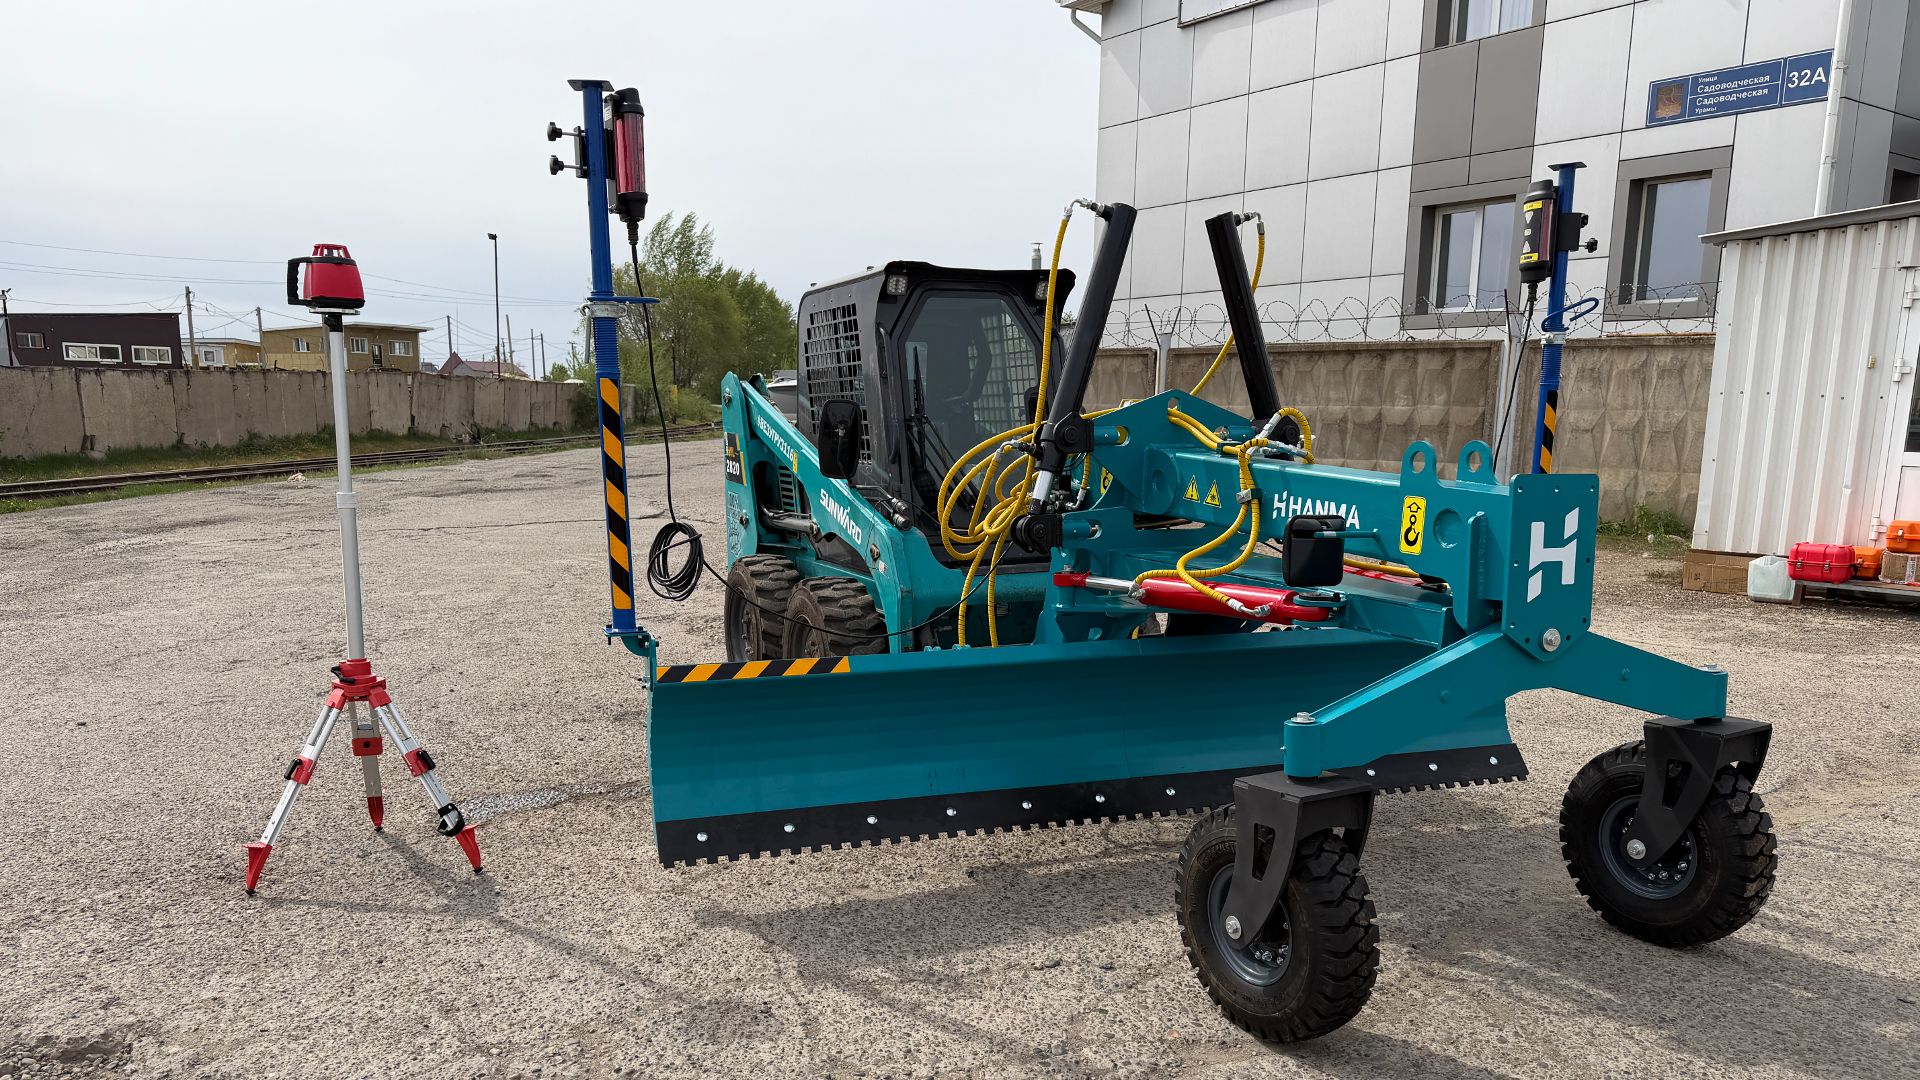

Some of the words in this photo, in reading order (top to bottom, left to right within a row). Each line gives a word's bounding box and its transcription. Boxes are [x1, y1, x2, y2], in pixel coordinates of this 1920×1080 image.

[1697, 75, 1770, 93] Садоводческая
[1788, 66, 1827, 88] 32А
[1696, 88, 1769, 105] Садоводческая
[1695, 106, 1717, 114] Урамы
[820, 488, 862, 544] SUNWARD
[1288, 495, 1361, 530] HANMA
